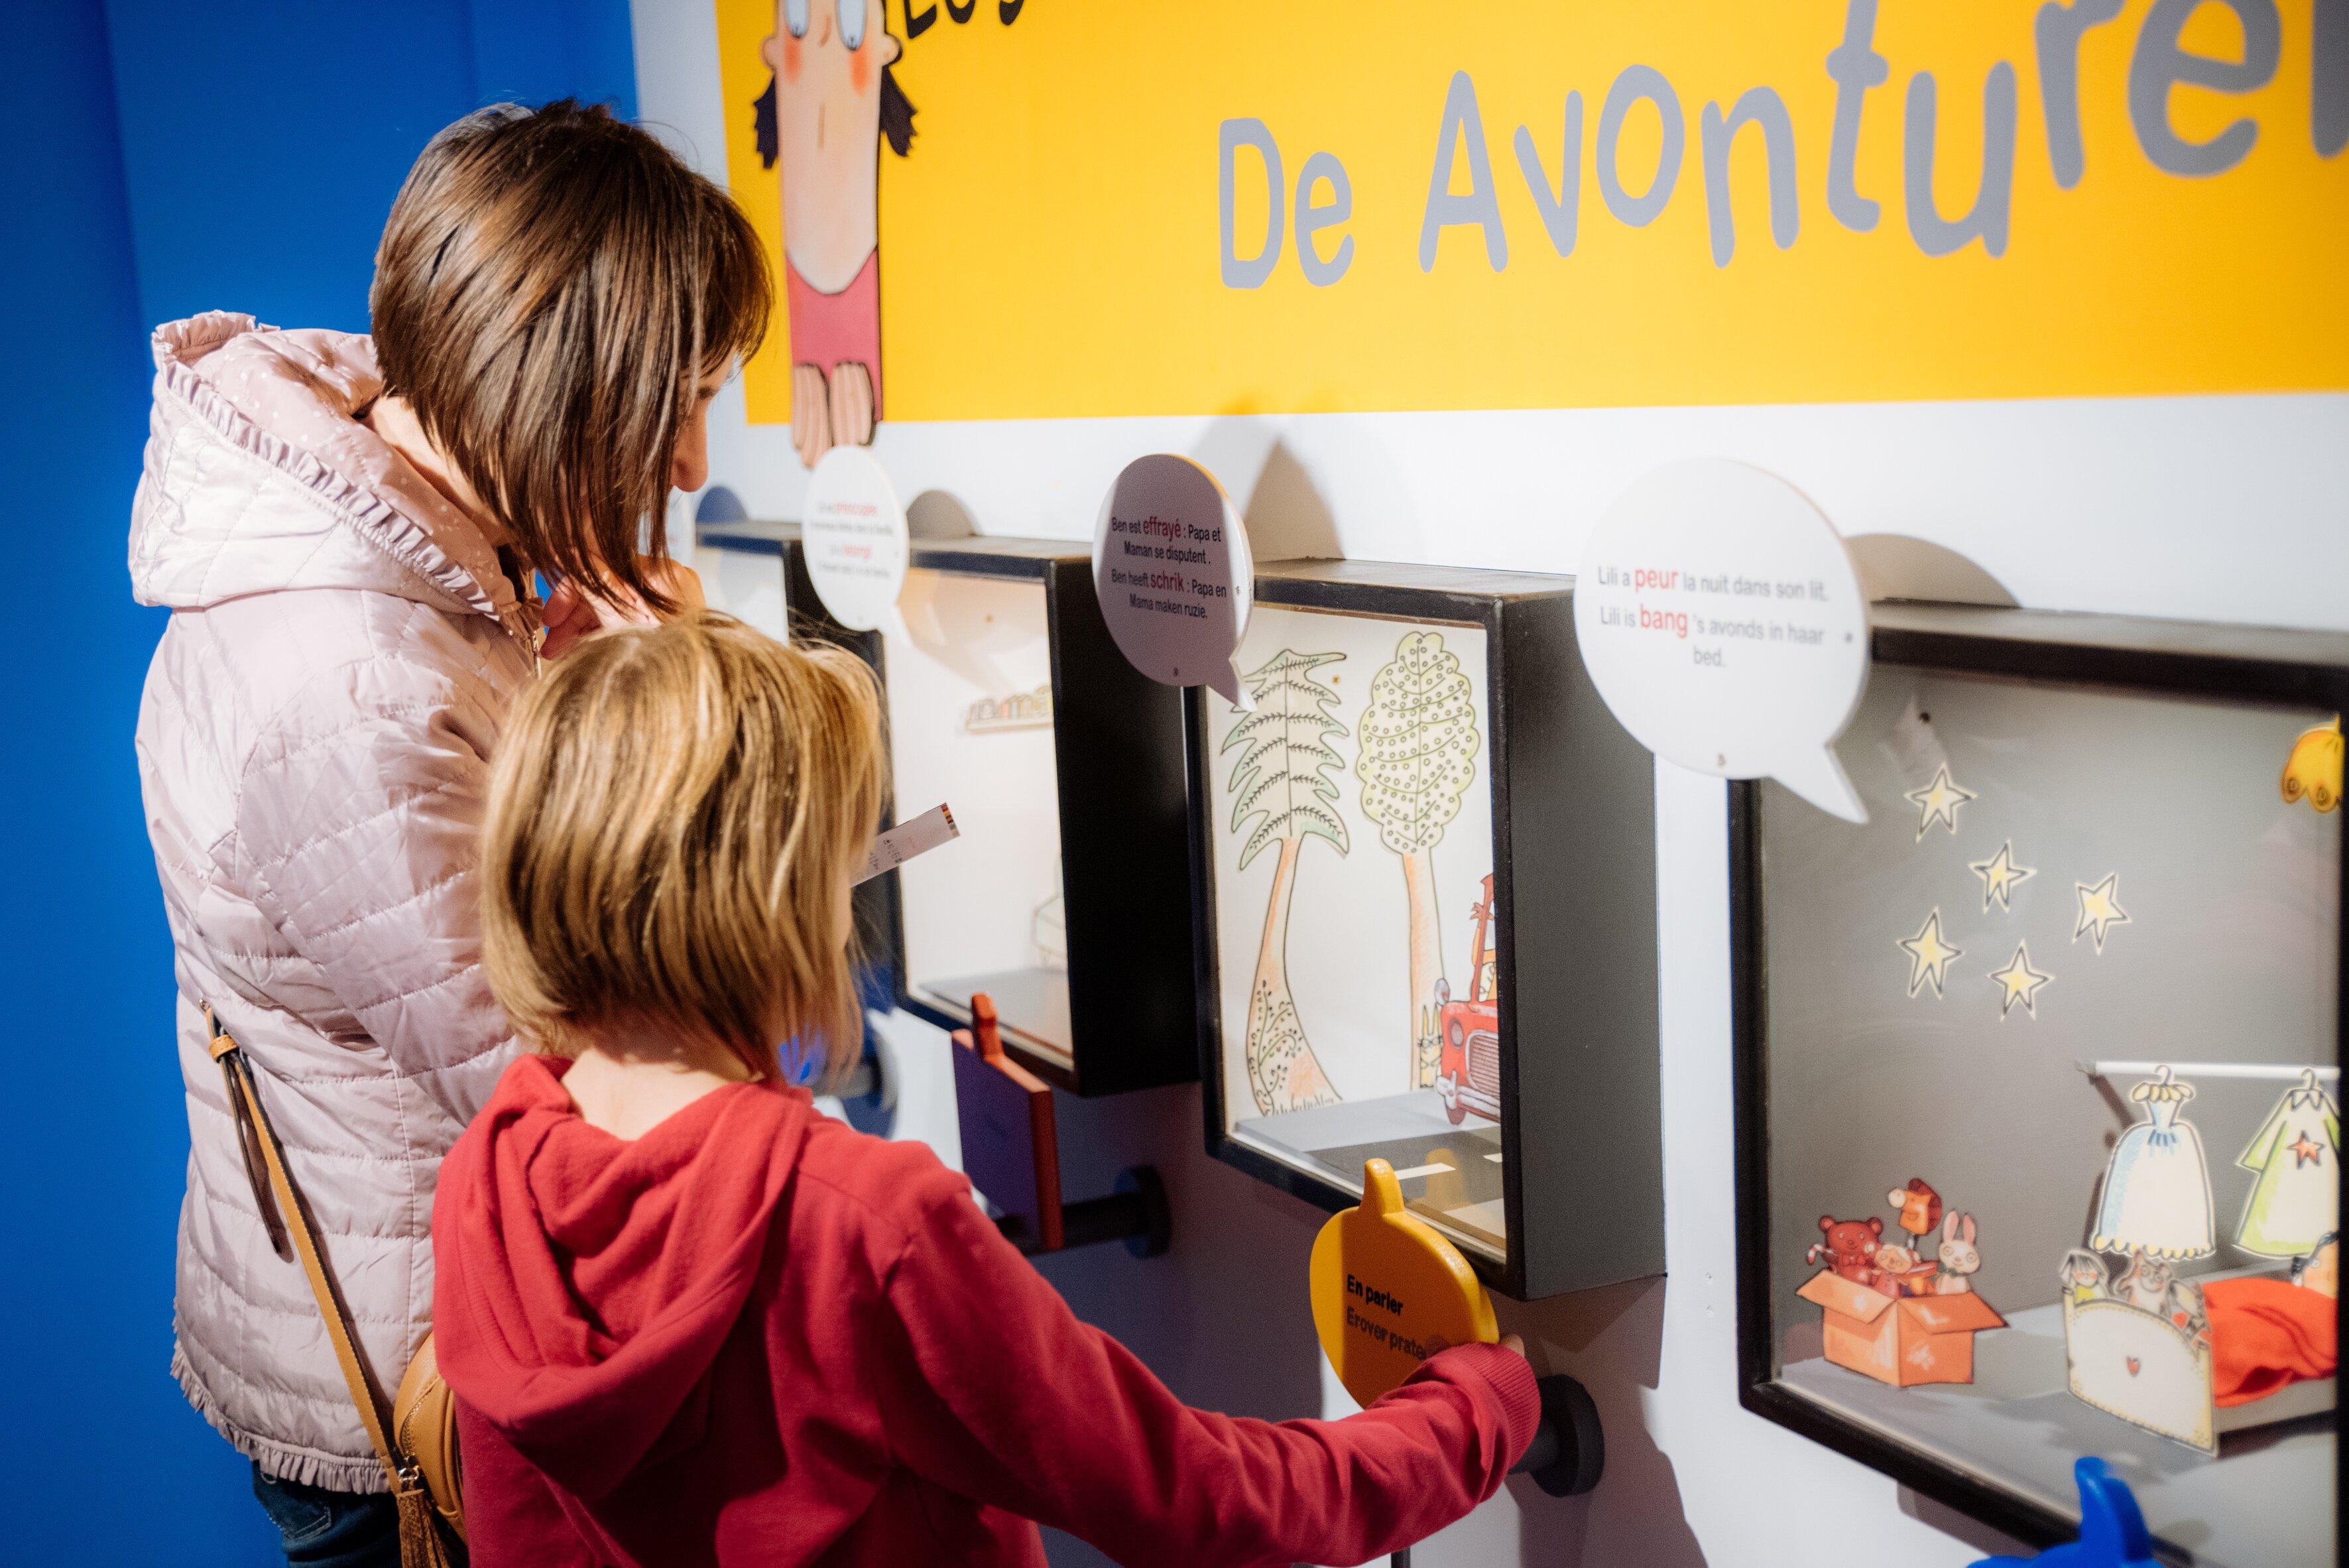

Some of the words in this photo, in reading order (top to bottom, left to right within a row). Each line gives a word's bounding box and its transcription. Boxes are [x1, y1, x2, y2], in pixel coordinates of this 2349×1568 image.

[1218, 117, 1356, 290] De
[1112, 516, 1127, 532] Ben
[1129, 520, 1141, 534] est
[1143, 516, 1181, 542] effrayé
[1188, 524, 1210, 543] Papa
[1212, 527, 1221, 542] et
[1124, 541, 1153, 558] Maman
[1154, 548, 1164, 559] se
[1166, 546, 1206, 564] disputent
[1111, 569, 1127, 584] Ben
[1128, 572, 1148, 587] heeft
[1150, 571, 1184, 592] schrik
[1191, 579, 1213, 599] Papa
[1215, 585, 1227, 597] en
[1598, 566, 1618, 585] Lili
[1622, 572, 1630, 587] a
[1635, 568, 1679, 593] peur
[1683, 572, 1696, 591] la
[1701, 574, 1728, 594] nuit
[1732, 575, 1770, 598] dans
[1776, 582, 1804, 599] son
[1809, 578, 1829, 601] lit.
[1130, 593, 1153, 610] Mama
[1155, 599, 1182, 615] maken
[1184, 603, 1208, 619] ruzie.
[1600, 606, 1620, 626] Lili
[1624, 609, 1636, 627] is
[1640, 603, 1688, 640] bang
[1709, 619, 1764, 640] avonds
[1770, 619, 1783, 640] in
[1787, 621, 1824, 646] haar
[1693, 645, 1726, 668] bed.
[1347, 1274, 1363, 1297] En
[1365, 1286, 1404, 1316] parler
